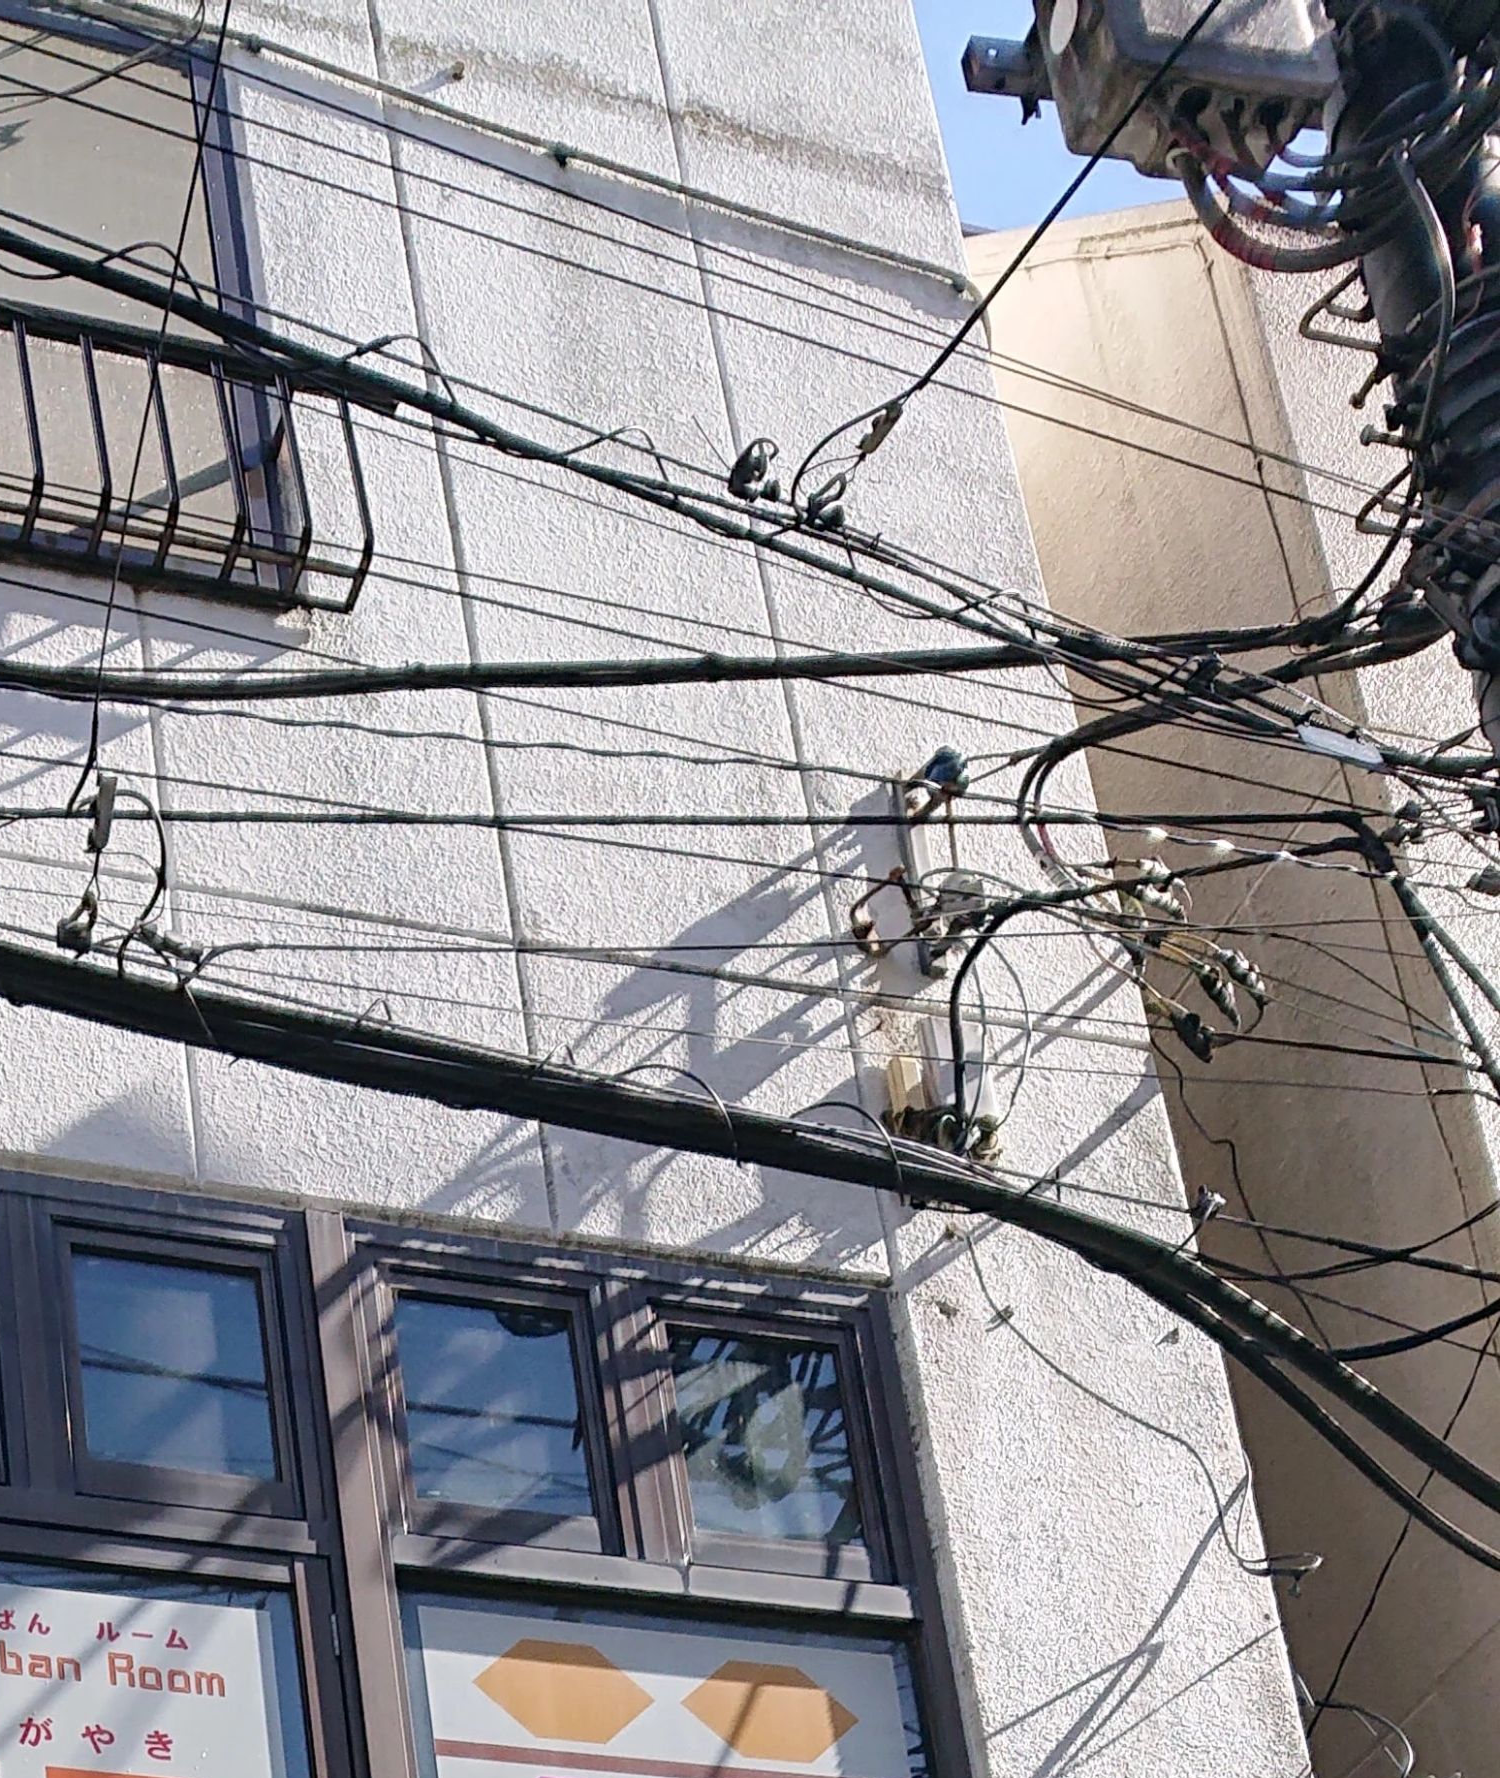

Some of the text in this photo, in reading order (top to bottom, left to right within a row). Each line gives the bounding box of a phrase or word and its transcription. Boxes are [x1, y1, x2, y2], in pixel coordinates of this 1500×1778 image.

[96, 1621, 189, 1650] ルーム
[108, 1652, 225, 1697] Room
